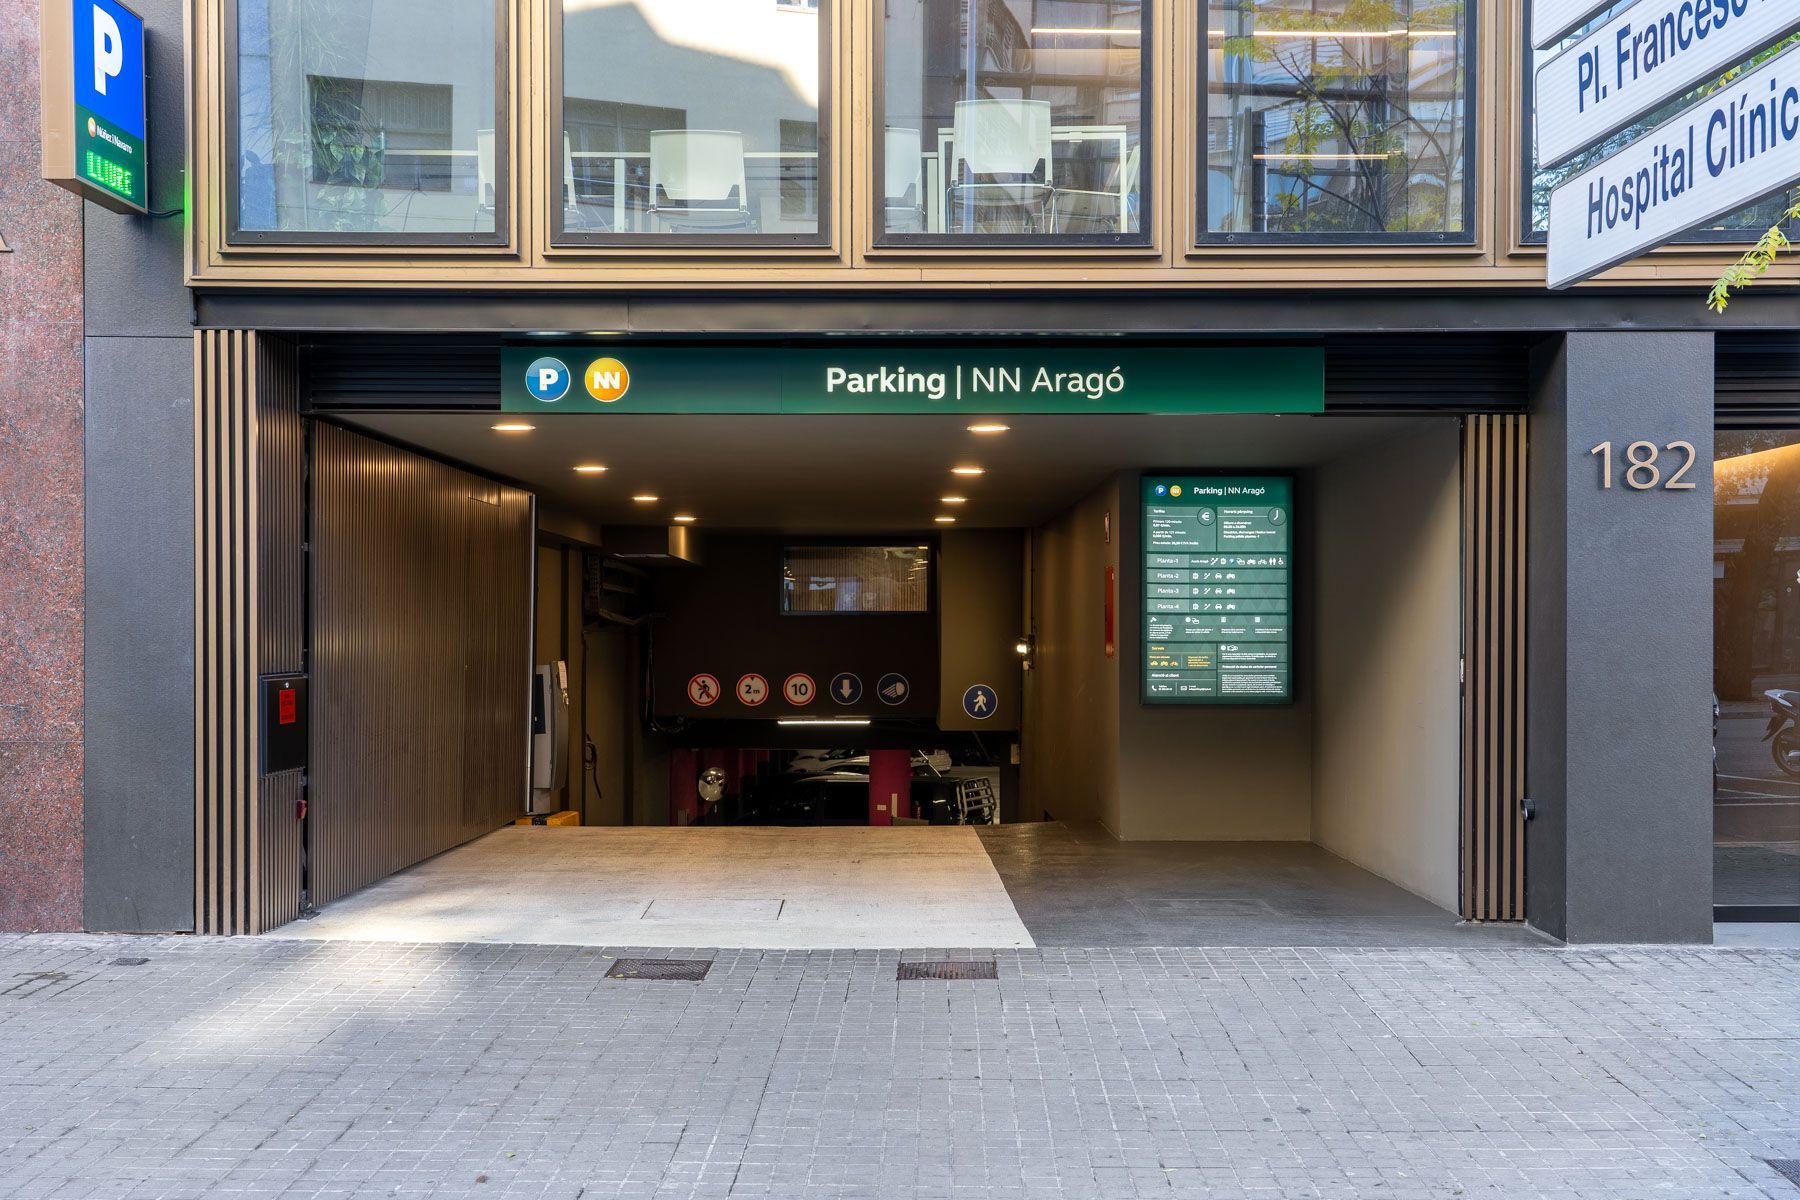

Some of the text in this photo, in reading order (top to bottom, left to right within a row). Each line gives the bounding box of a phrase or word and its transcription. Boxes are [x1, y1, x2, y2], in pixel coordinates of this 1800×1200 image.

[93, 3, 123, 96] P
[1578, 45, 1607, 113] Pl.
[1587, 125, 1693, 239] Hospital
[539, 368, 559, 391] P
[826, 365, 1125, 400] Parking NN Aragó
[1590, 440, 1696, 490] 182
[1193, 487, 1223, 496] Parking
[1242, 487, 1265, 496] Aragó
[791, 683, 808, 696] 10
